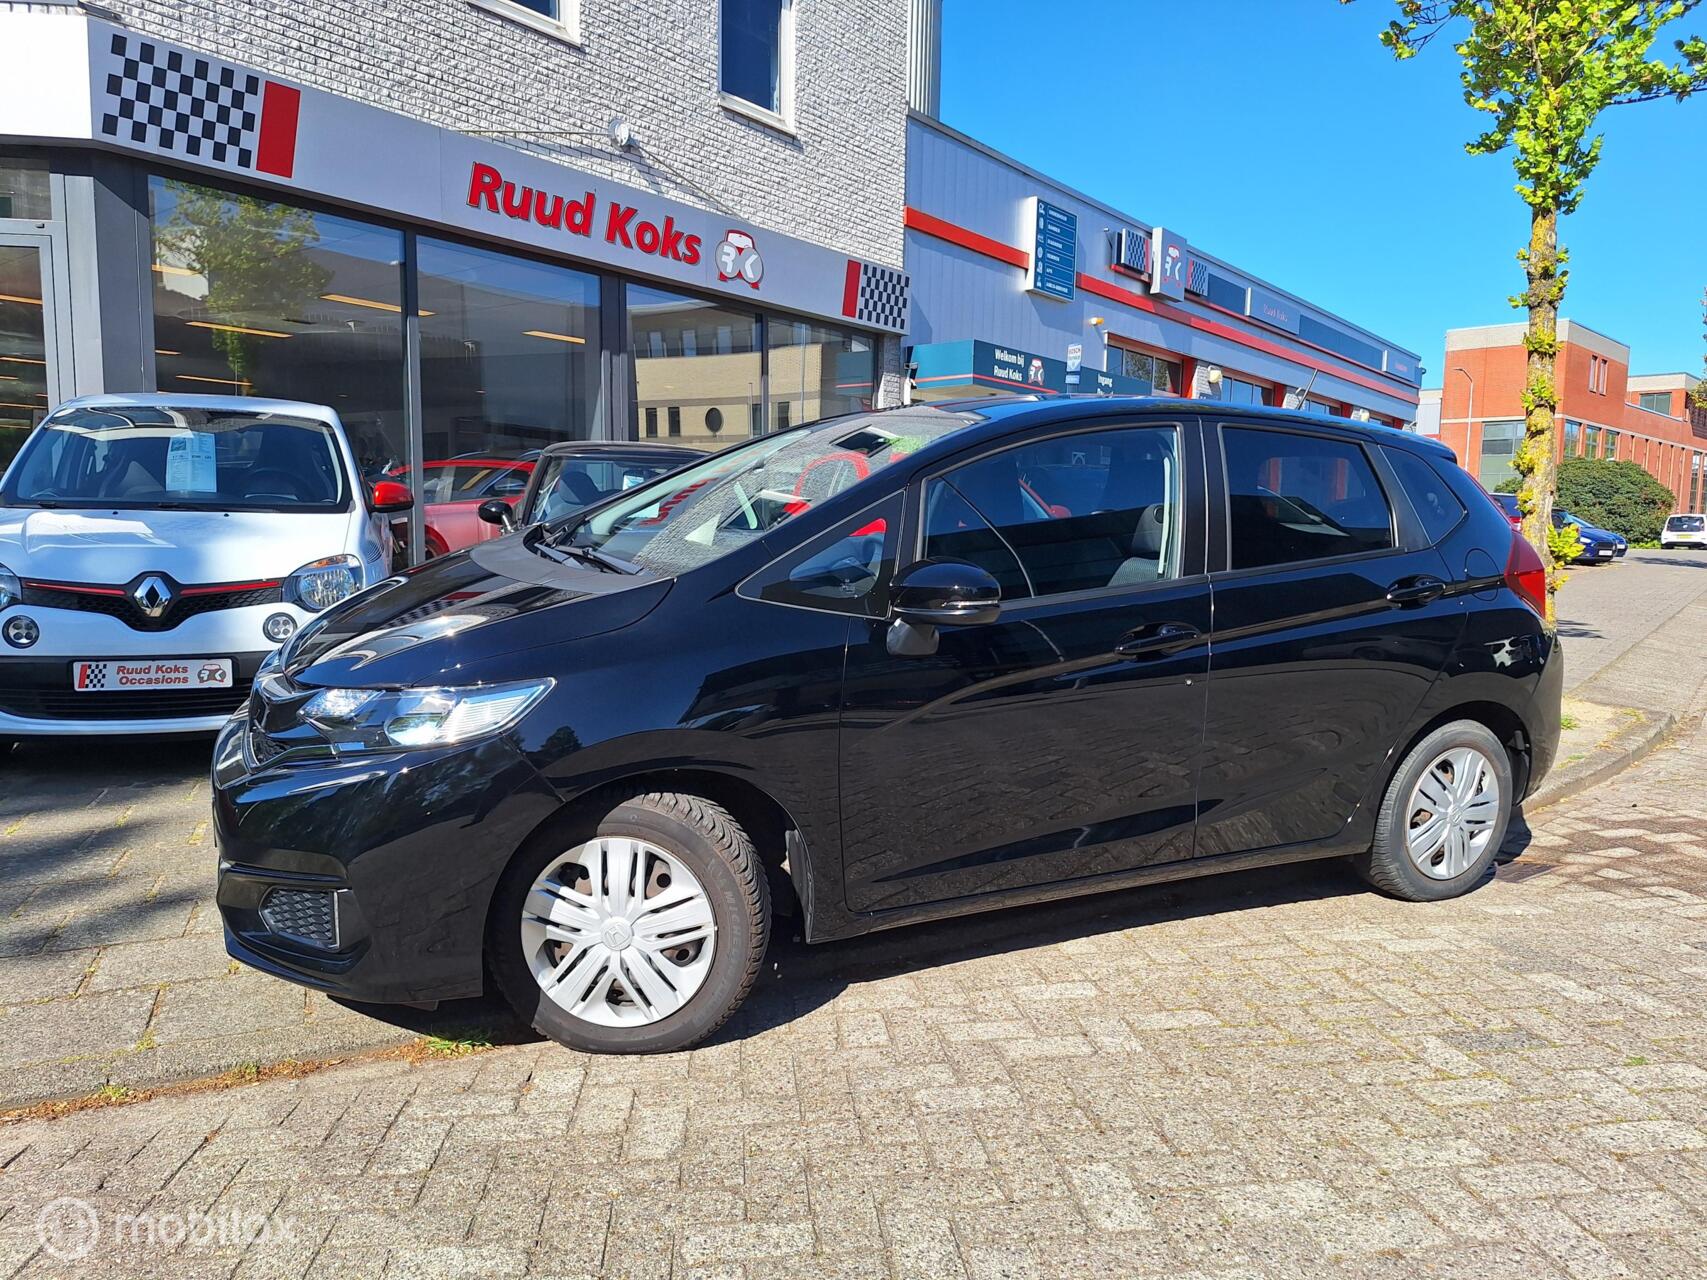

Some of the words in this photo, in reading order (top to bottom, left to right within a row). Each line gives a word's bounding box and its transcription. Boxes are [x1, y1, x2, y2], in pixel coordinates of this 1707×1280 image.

[466, 161, 596, 237] Ruud
[604, 201, 703, 266] Koks
[995, 349, 1016, 363] Welkom
[1017, 353, 1025, 368] bij
[994, 365, 1008, 378] Ruud
[1009, 369, 1022, 381] Koks
[1098, 374, 1113, 387] Ingang
[116, 664, 152, 675] Ruud
[154, 663, 189, 675] Koks
[118, 675, 189, 686] Occasions
